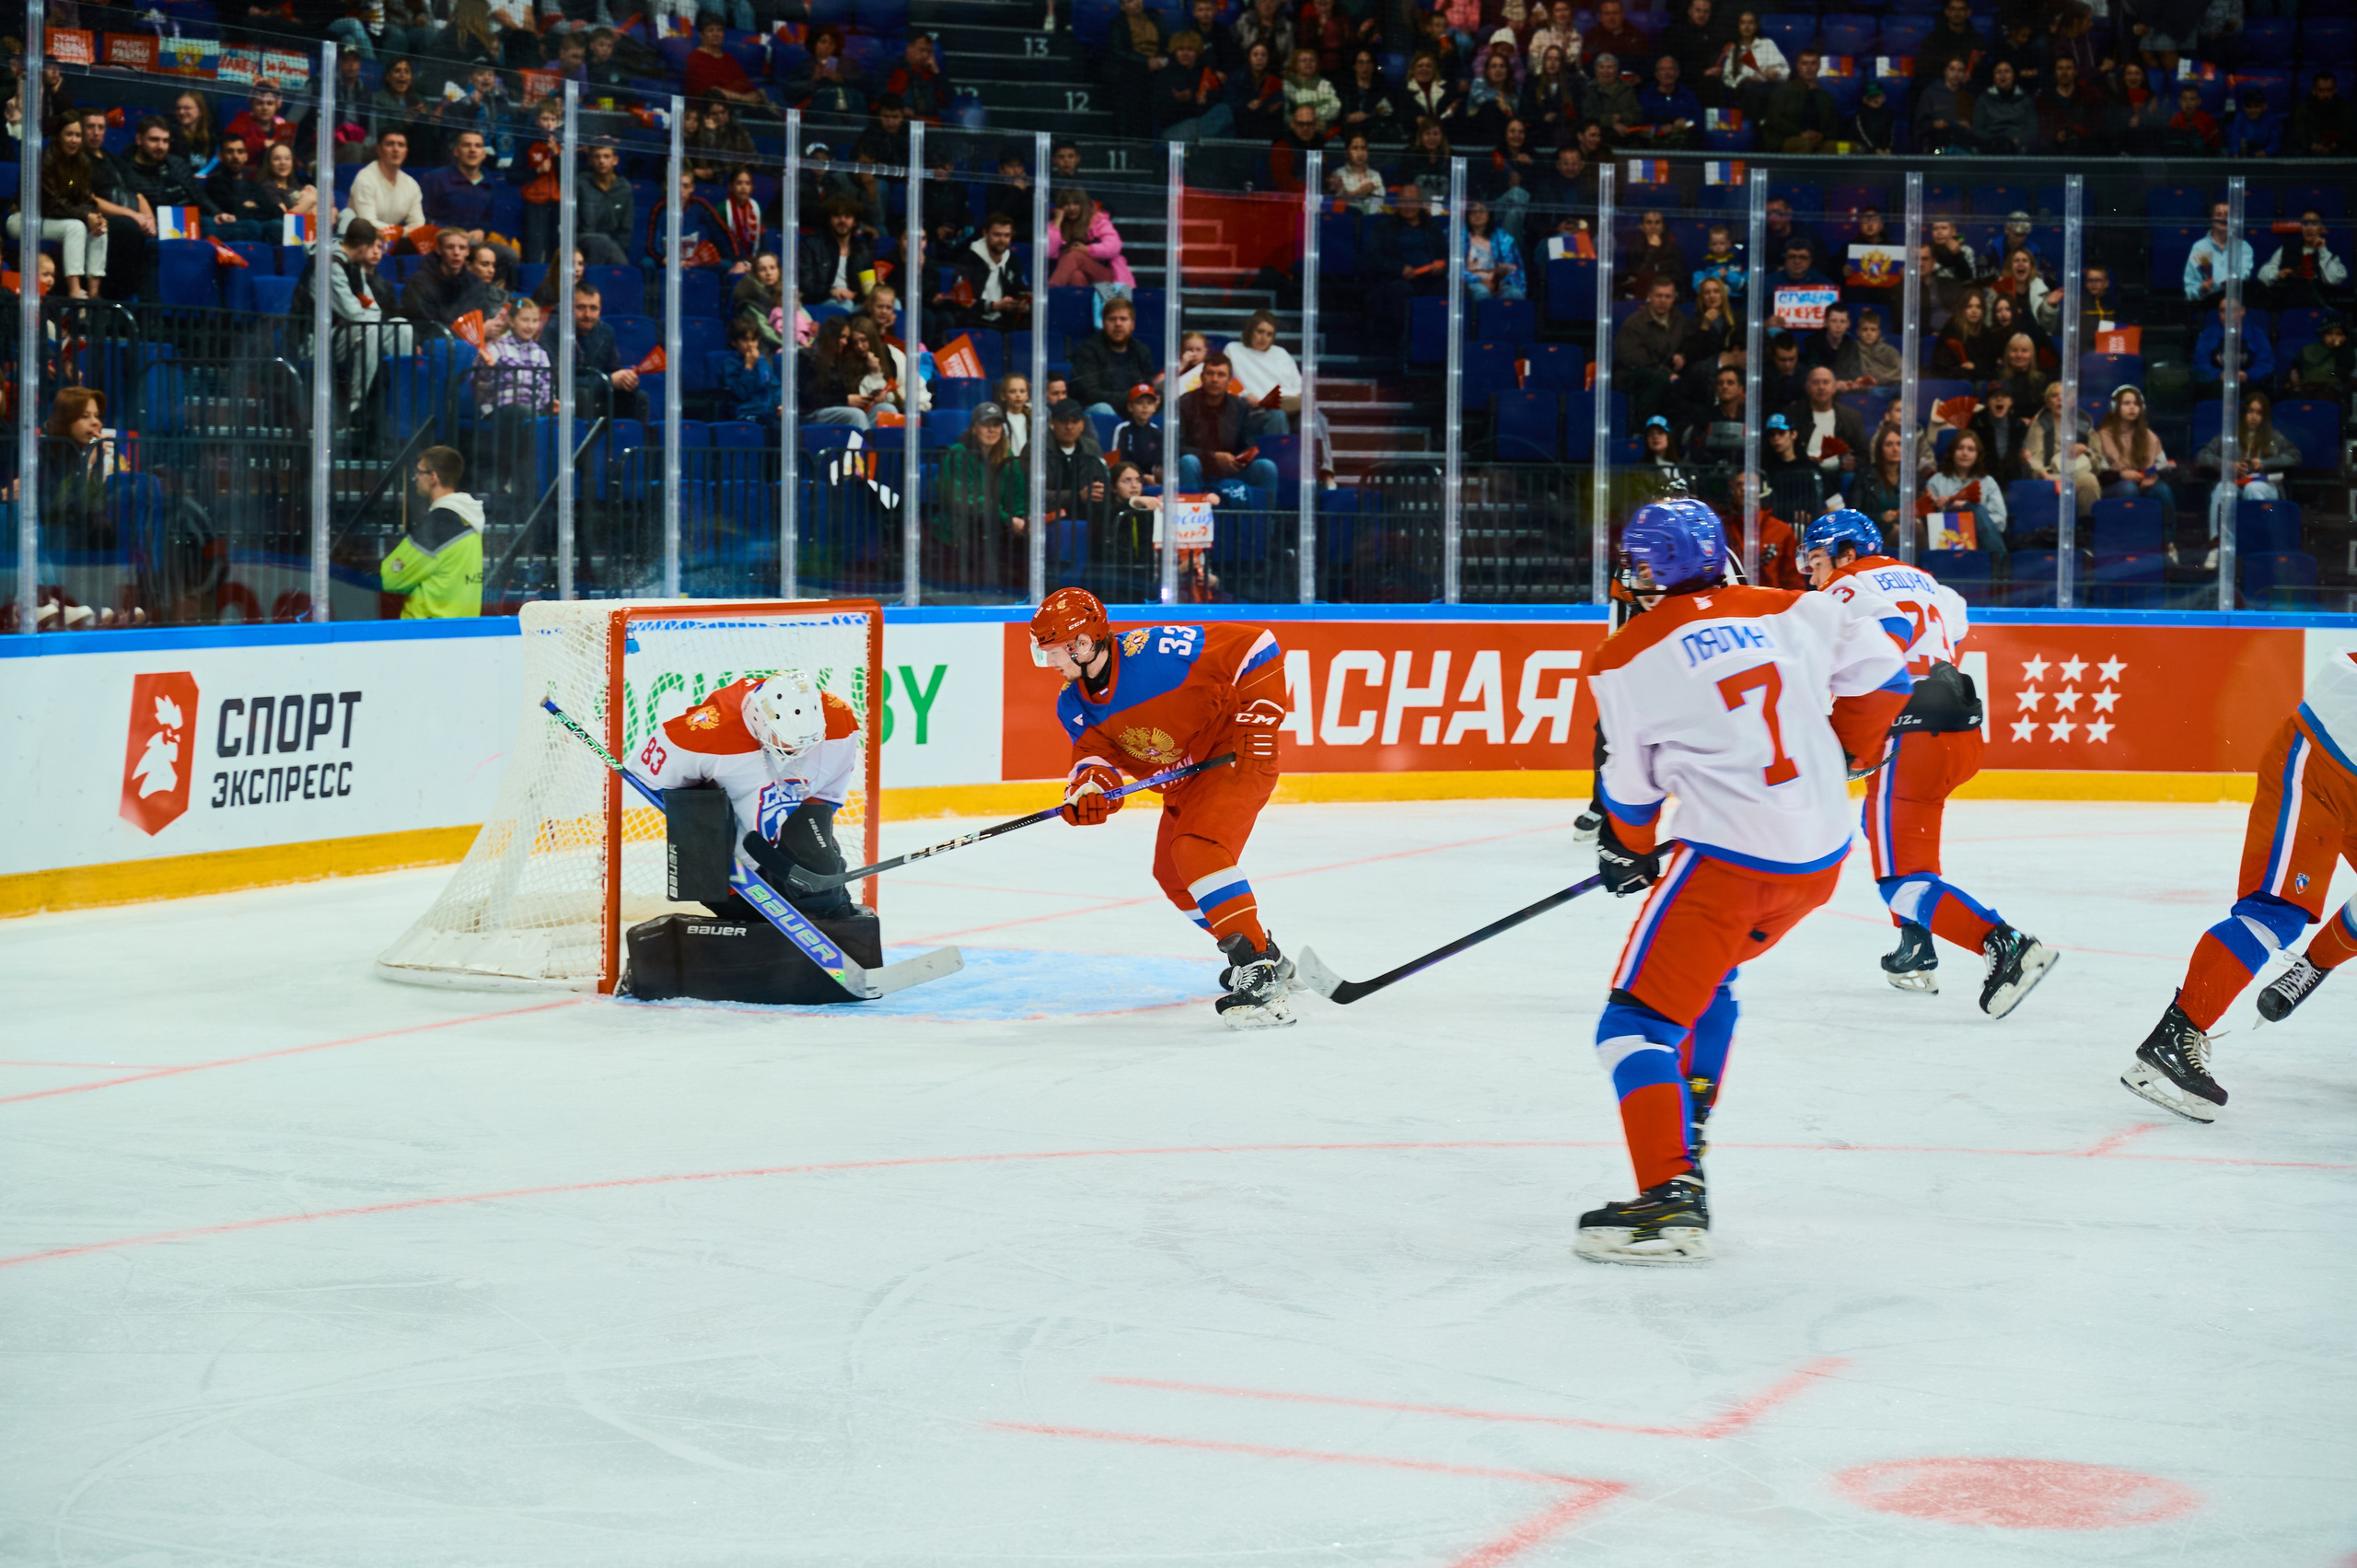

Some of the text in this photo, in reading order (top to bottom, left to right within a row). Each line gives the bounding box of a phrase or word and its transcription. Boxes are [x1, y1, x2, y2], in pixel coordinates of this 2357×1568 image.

[1024, 38, 1049, 57] 13
[1064, 91, 1089, 111] 12
[1108, 150, 1127, 171] 11
[1158, 625, 1197, 656] 33
[1278, 649, 1583, 746] АСНАЯ
[216, 691, 362, 758] СПОРТ
[1235, 713, 1278, 726] CM
[1714, 660, 1802, 787] 7
[641, 737, 667, 776] 83
[211, 761, 353, 808] ЭКСПРЕСС
[686, 925, 748, 937] BAUER
[744, 884, 838, 963] BAUER
